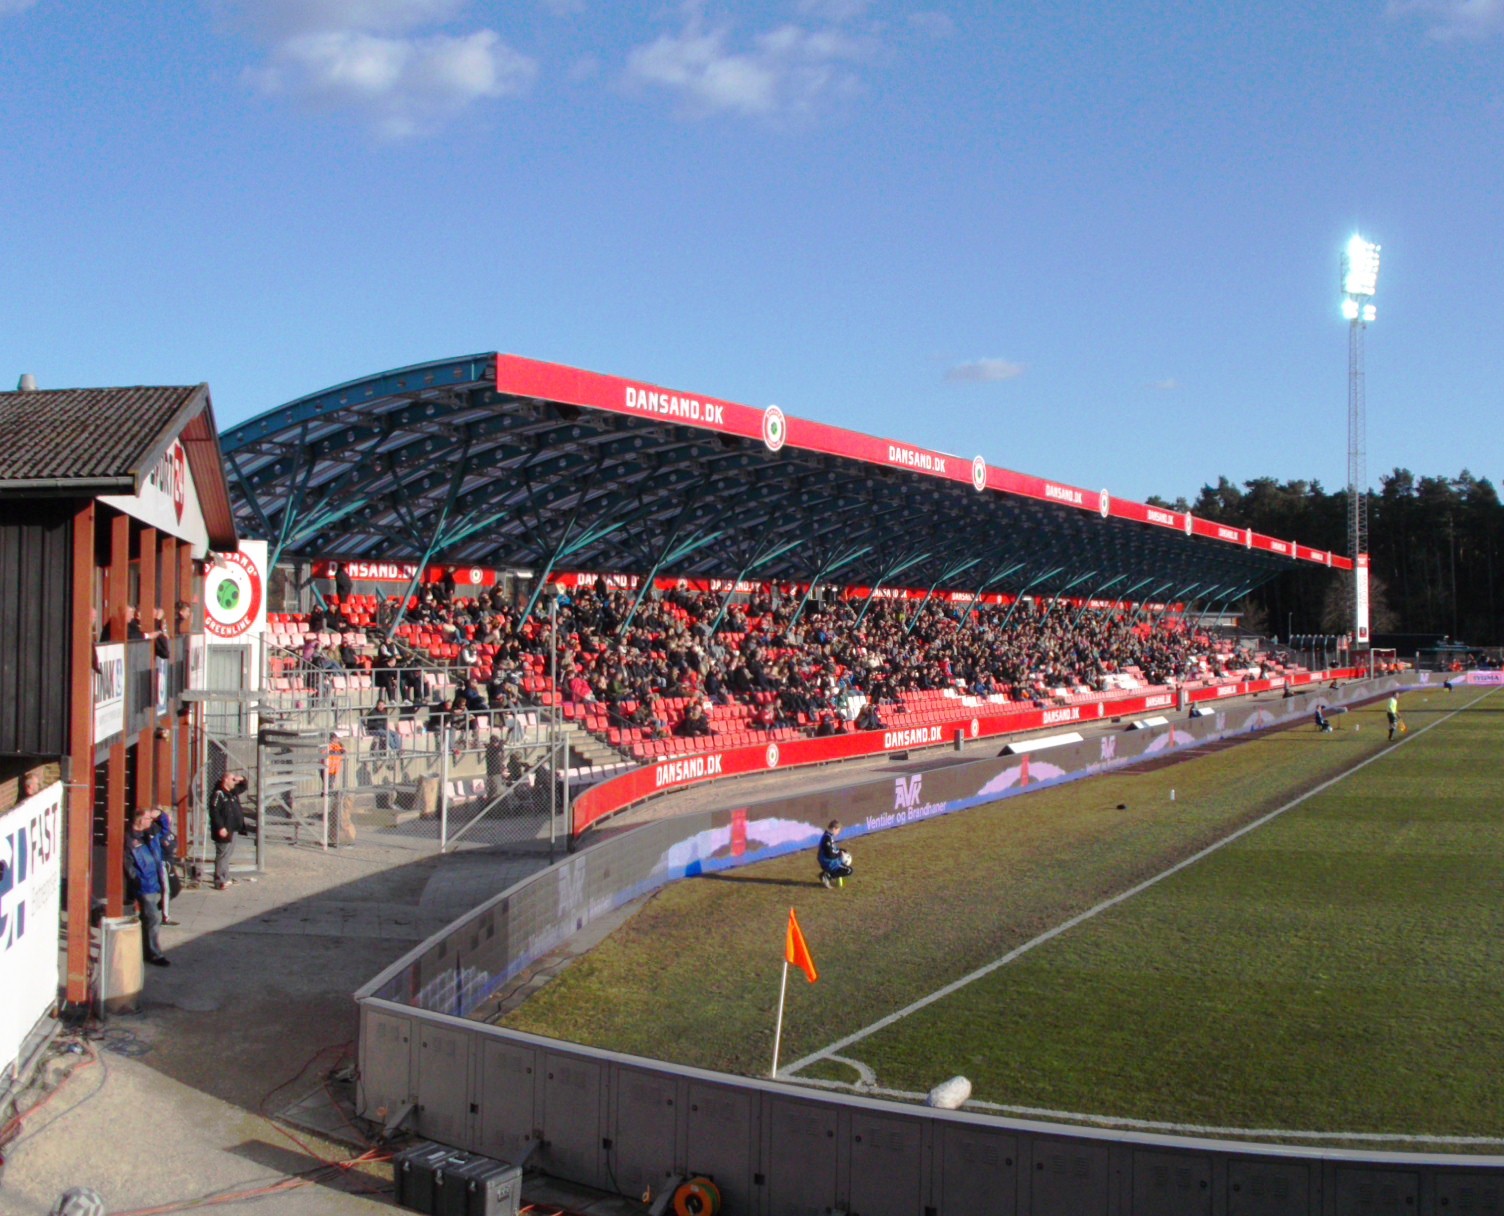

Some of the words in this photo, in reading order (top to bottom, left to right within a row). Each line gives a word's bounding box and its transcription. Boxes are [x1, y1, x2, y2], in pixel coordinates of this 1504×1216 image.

[626, 387, 723, 424] DANSAND.DK
[889, 446, 946, 473] DANSAND.DK
[1045, 485, 1082, 504] DANSAND.DK
[205, 616, 250, 637] GREENLINE
[1043, 707, 1080, 724] DANSAND.DK
[885, 726, 942, 749] DANSAND.DK
[656, 753, 722, 787] DANSAND.DK
[895, 774, 922, 810] AVK
[866, 811, 895, 831] Ventiler
[896, 809, 906, 824] og
[907, 799, 947, 820] Brandhaner
[30, 802, 58, 875] FAST
